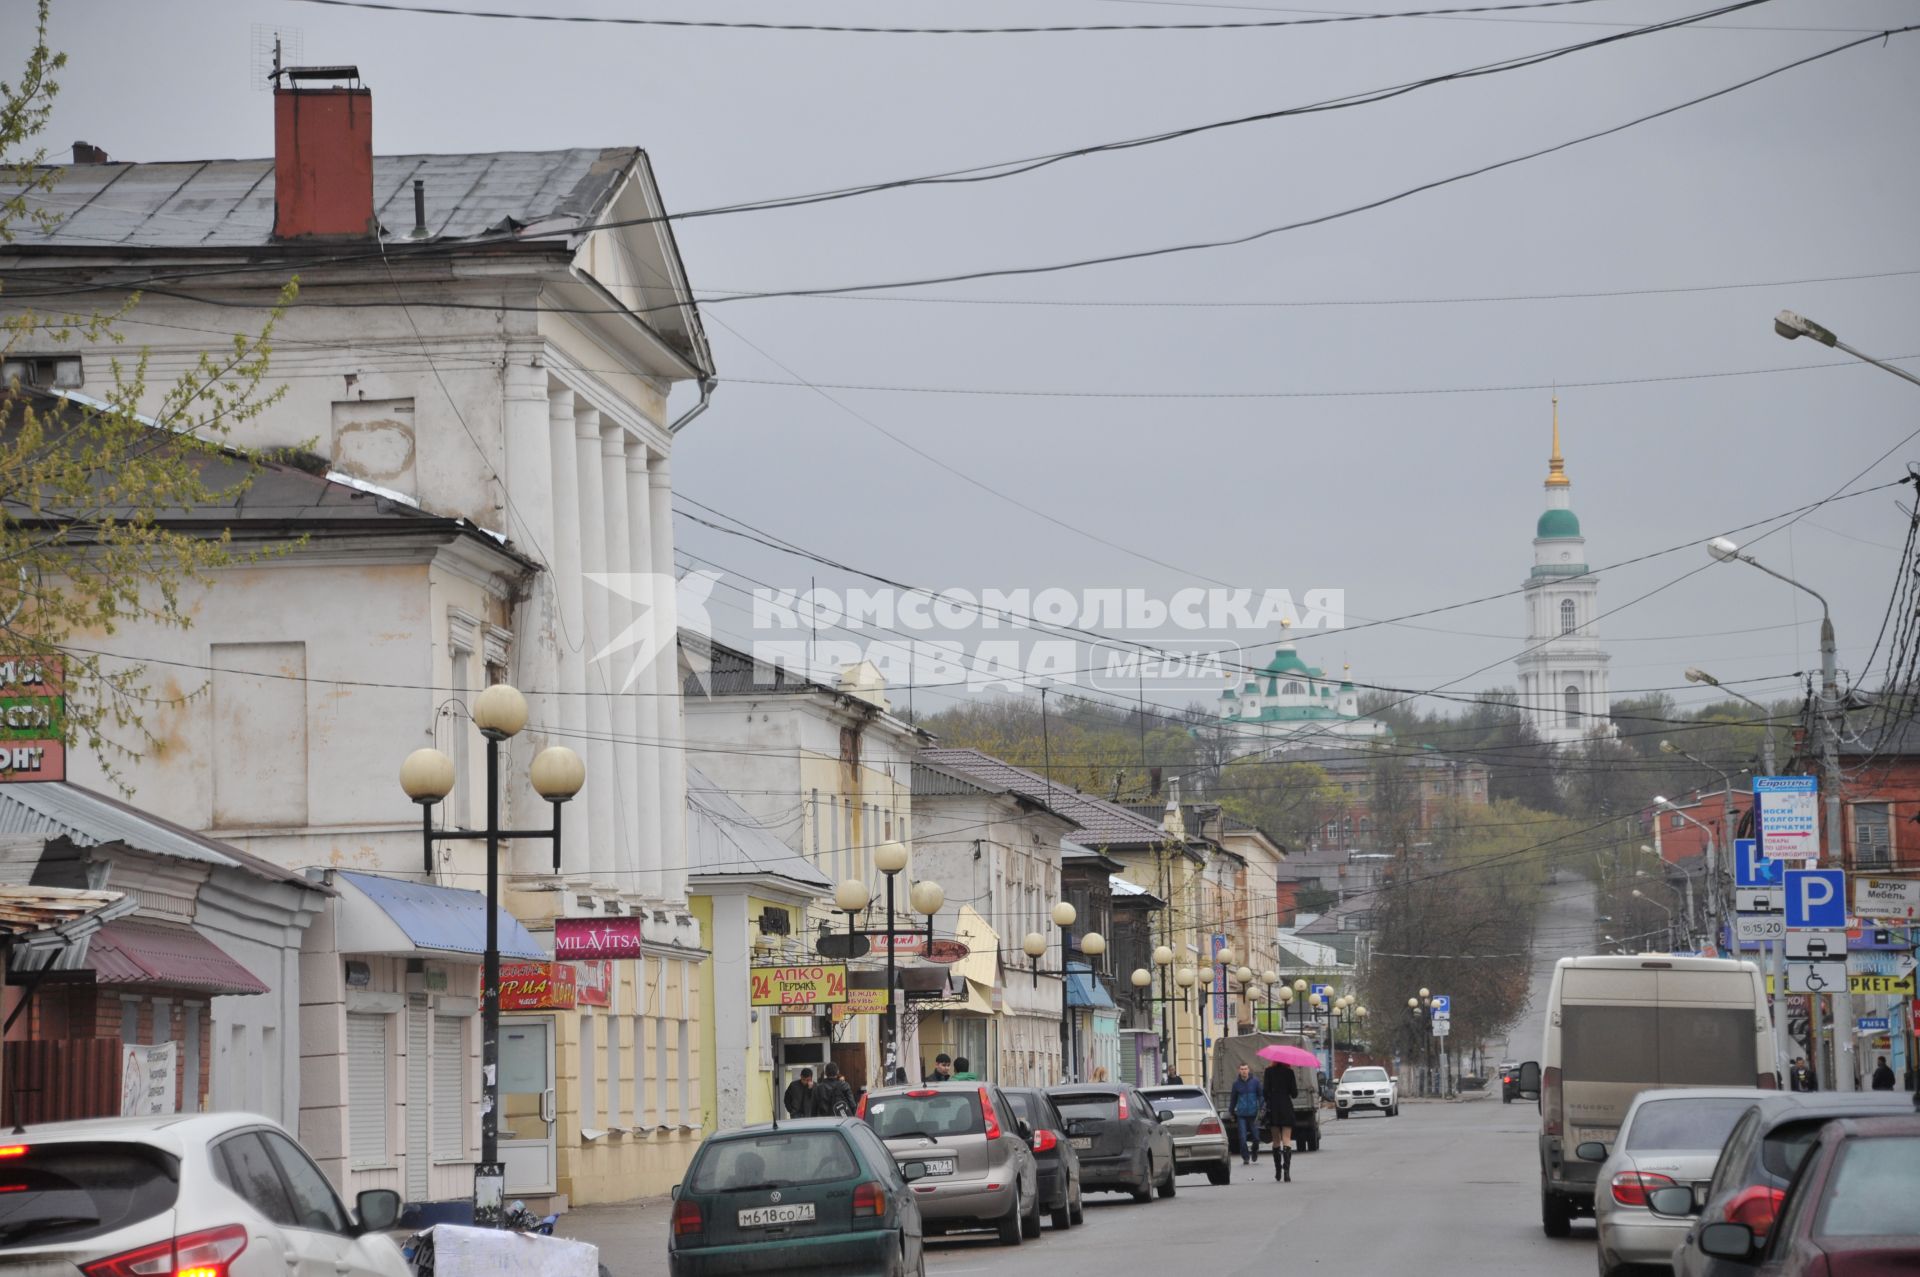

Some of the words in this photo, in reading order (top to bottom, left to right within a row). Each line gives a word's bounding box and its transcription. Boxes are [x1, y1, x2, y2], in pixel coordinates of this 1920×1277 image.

[1869, 880, 1907, 891] Шатура
[1801, 876, 1834, 922] P
[1867, 890, 1906, 900] Мебель
[1753, 923, 1763, 933] 15
[1766, 922, 1781, 933] 20
[556, 930, 640, 951] MILAVITSA
[752, 975, 771, 999] 24
[827, 972, 846, 997] 24
[781, 991, 817, 1004] БАР
[798, 1205, 811, 1216] 71
